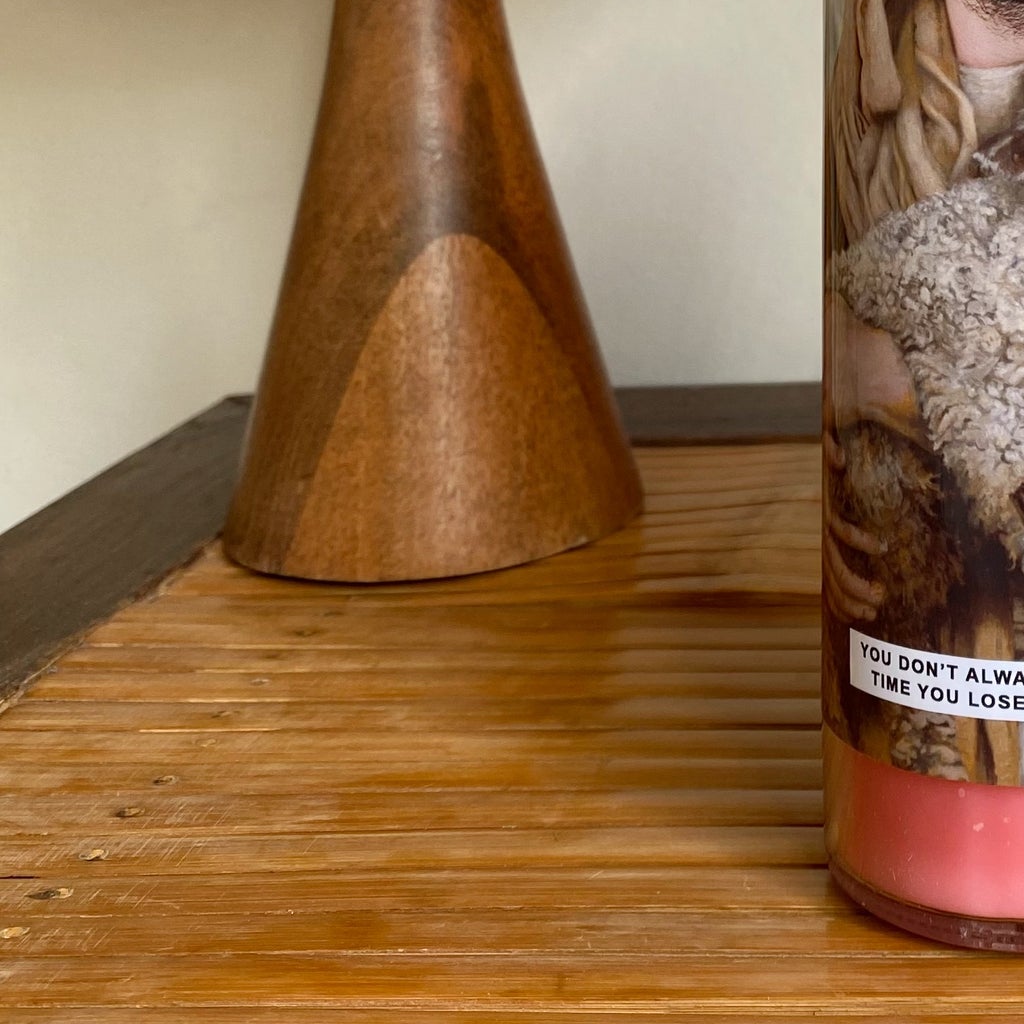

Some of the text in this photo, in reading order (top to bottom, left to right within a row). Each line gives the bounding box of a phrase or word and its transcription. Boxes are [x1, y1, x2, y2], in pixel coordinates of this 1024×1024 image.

[860, 640, 892, 667] YOU
[871, 669, 912, 697] TIME
[917, 682, 959, 706] YOU
